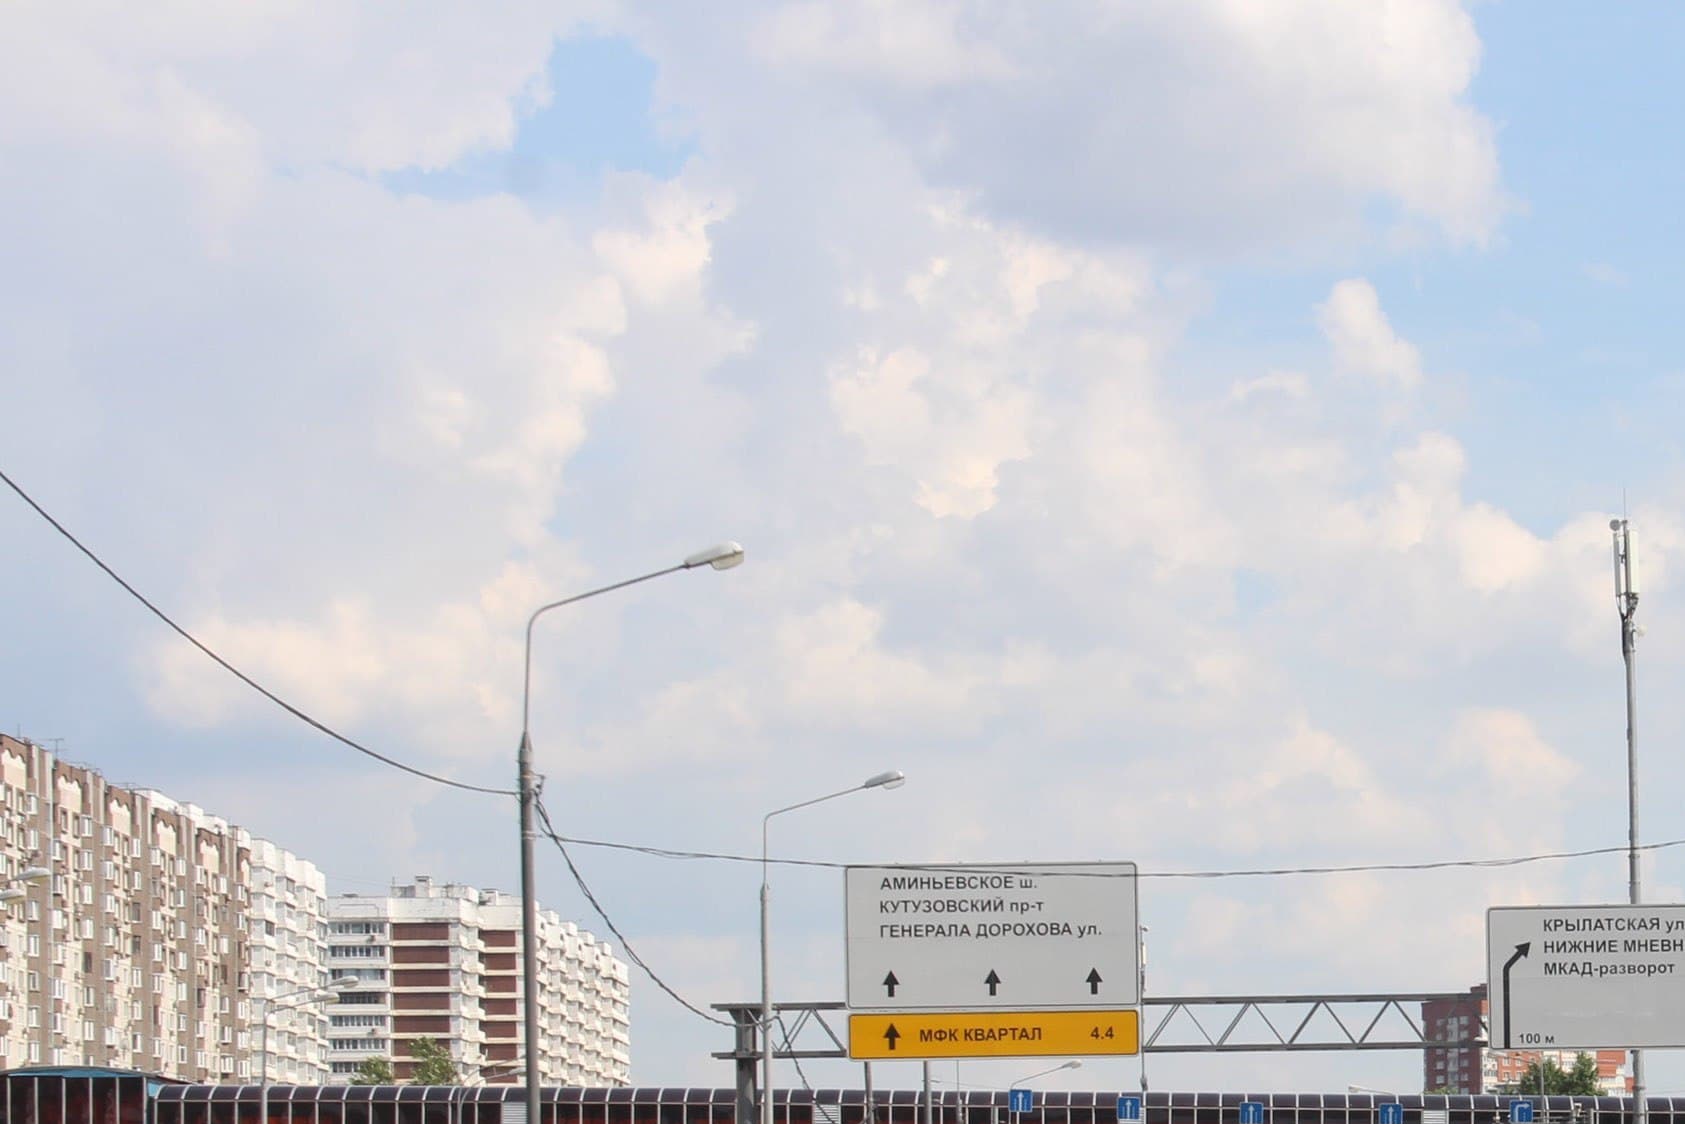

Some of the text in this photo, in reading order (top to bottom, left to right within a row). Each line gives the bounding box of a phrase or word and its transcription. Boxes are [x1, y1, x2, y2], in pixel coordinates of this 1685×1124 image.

[880, 876, 1038, 890] АМИНЬЕВСКОЕ ш.
[880, 897, 1045, 915] КУТУЗОВСКИЙ пр-т
[880, 922, 1102, 939] ГЕНЕРАЛА ДОРОХОВА ул.
[1543, 917, 1660, 932] КРЫЛАТСКАЯ
[1543, 939, 1618, 954] НИЖНИЕ
[1543, 961, 1675, 977] МКАД-разворот
[919, 1026, 1115, 1043] МФК КВАРТАЛ 4.4
[1519, 1033, 1555, 1044] 100 м
